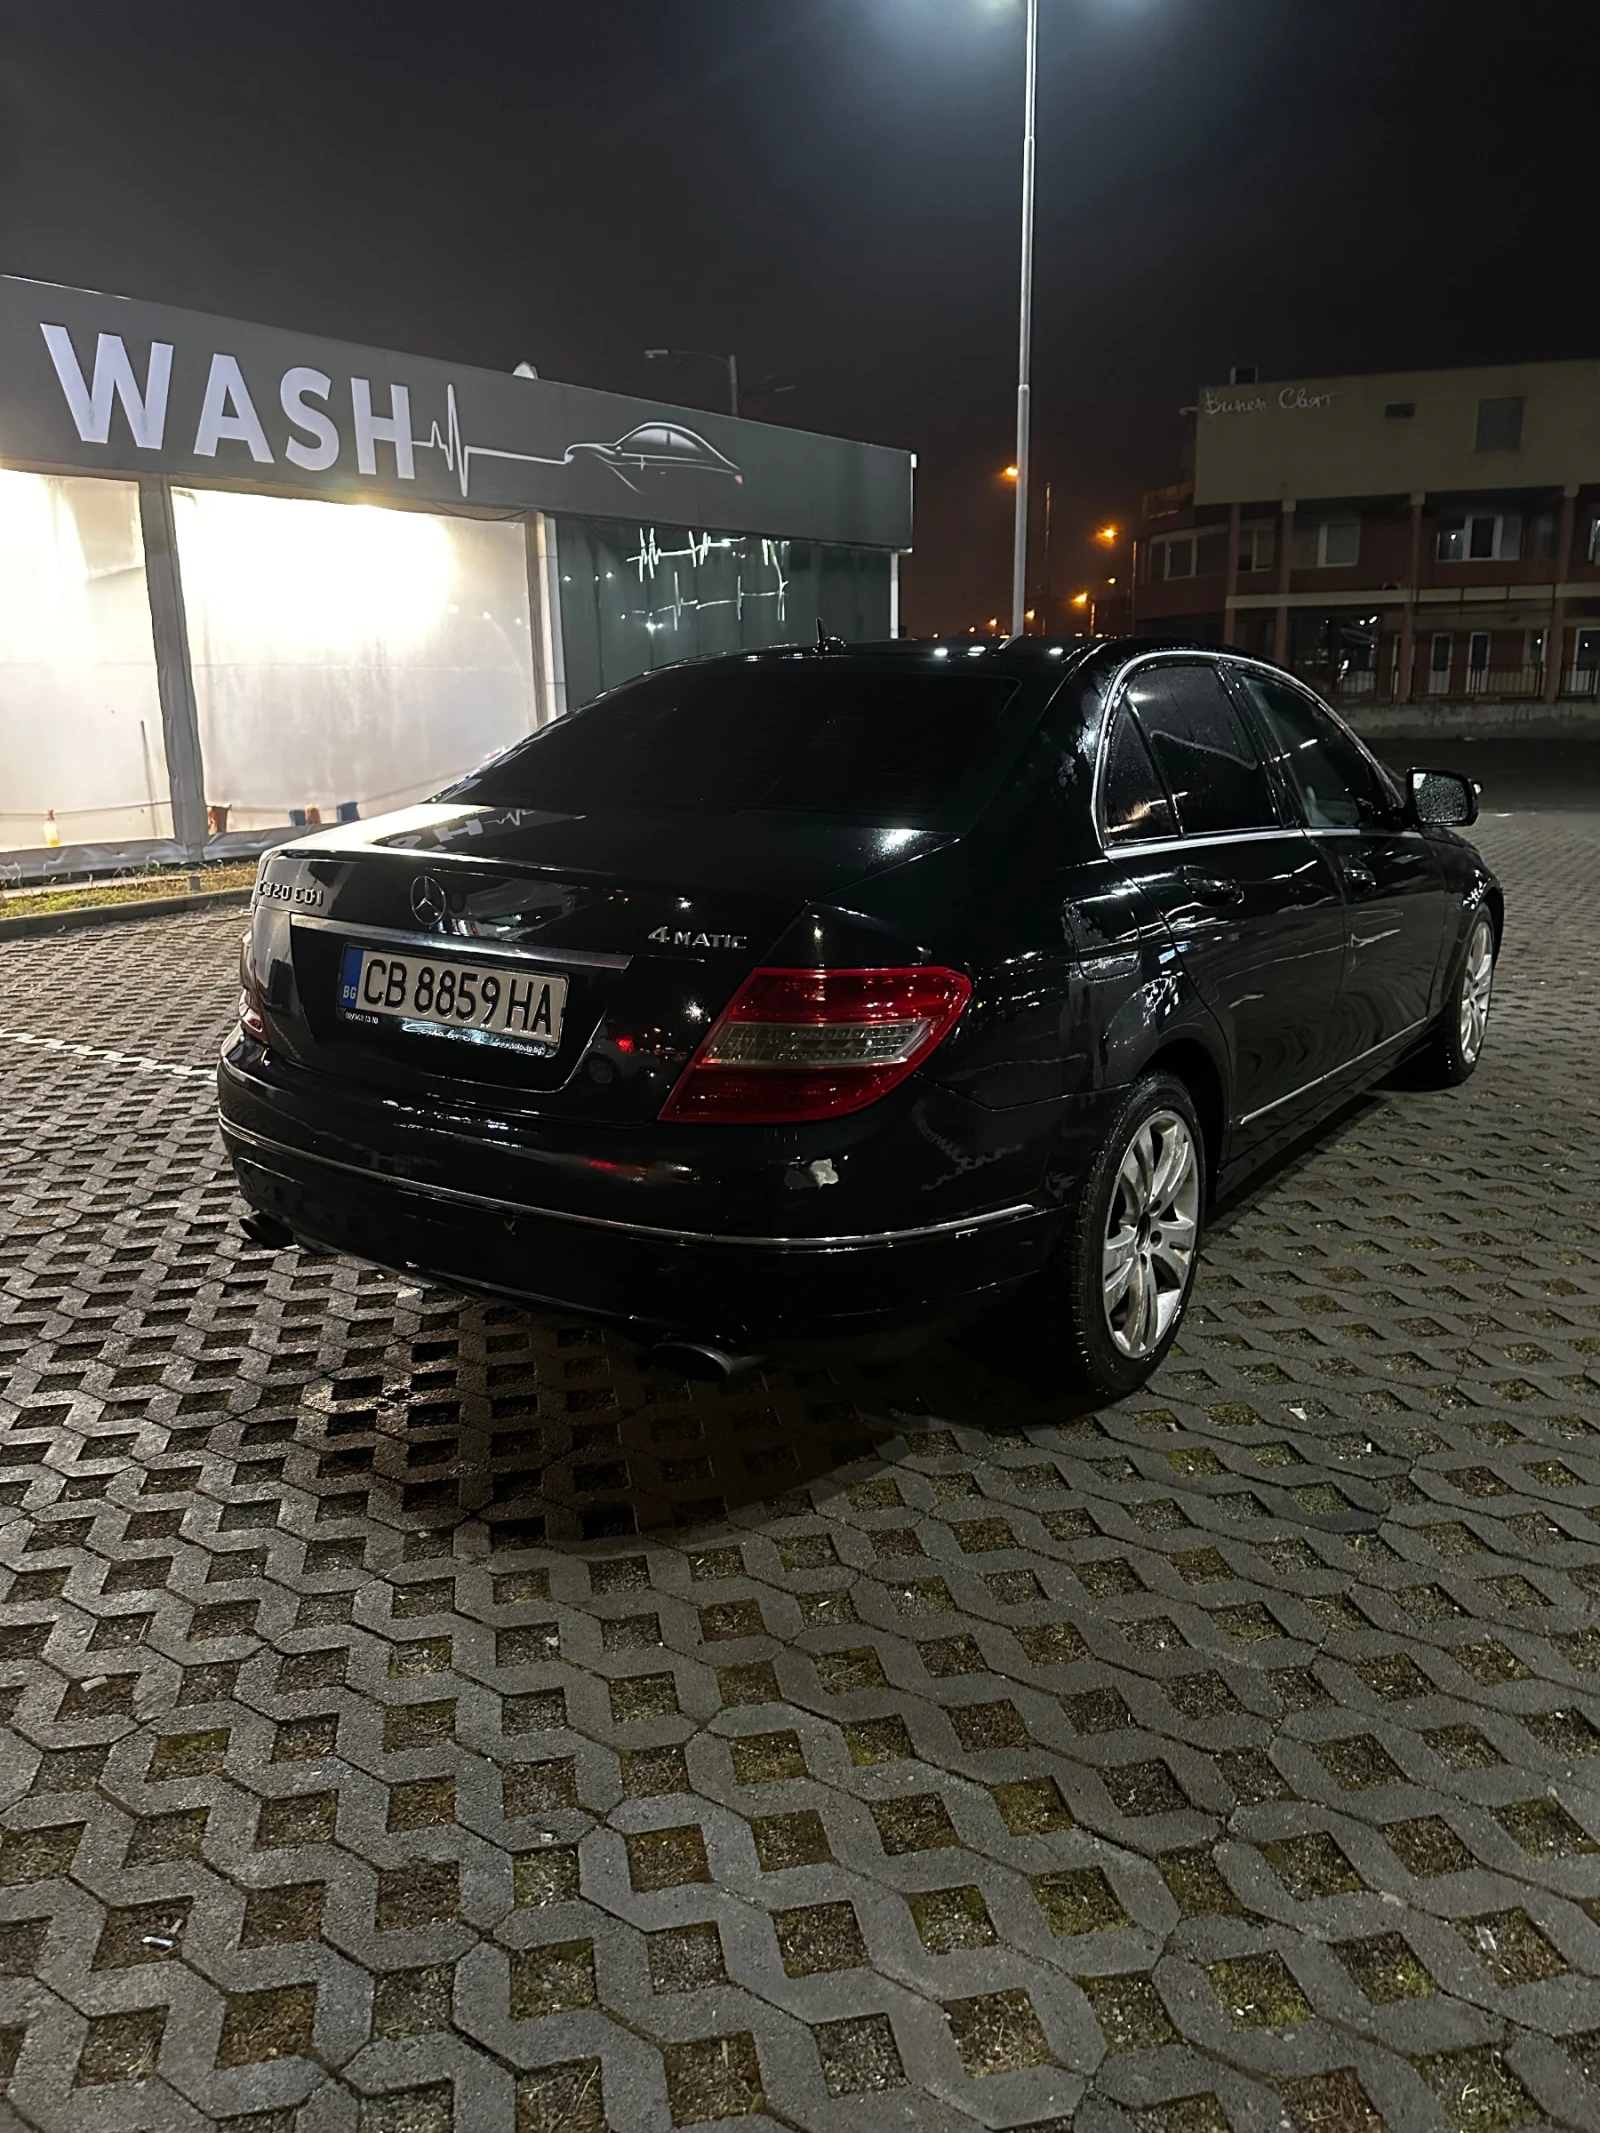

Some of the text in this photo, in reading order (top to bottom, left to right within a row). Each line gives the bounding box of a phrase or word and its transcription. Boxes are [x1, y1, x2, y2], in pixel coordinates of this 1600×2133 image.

[40, 322, 415, 479] WASH
[1278, 387, 1340, 409] Свят
[295, 887, 323, 906] CDI
[343, 985, 357, 999] BG
[414, 967, 500, 1027] 8859
